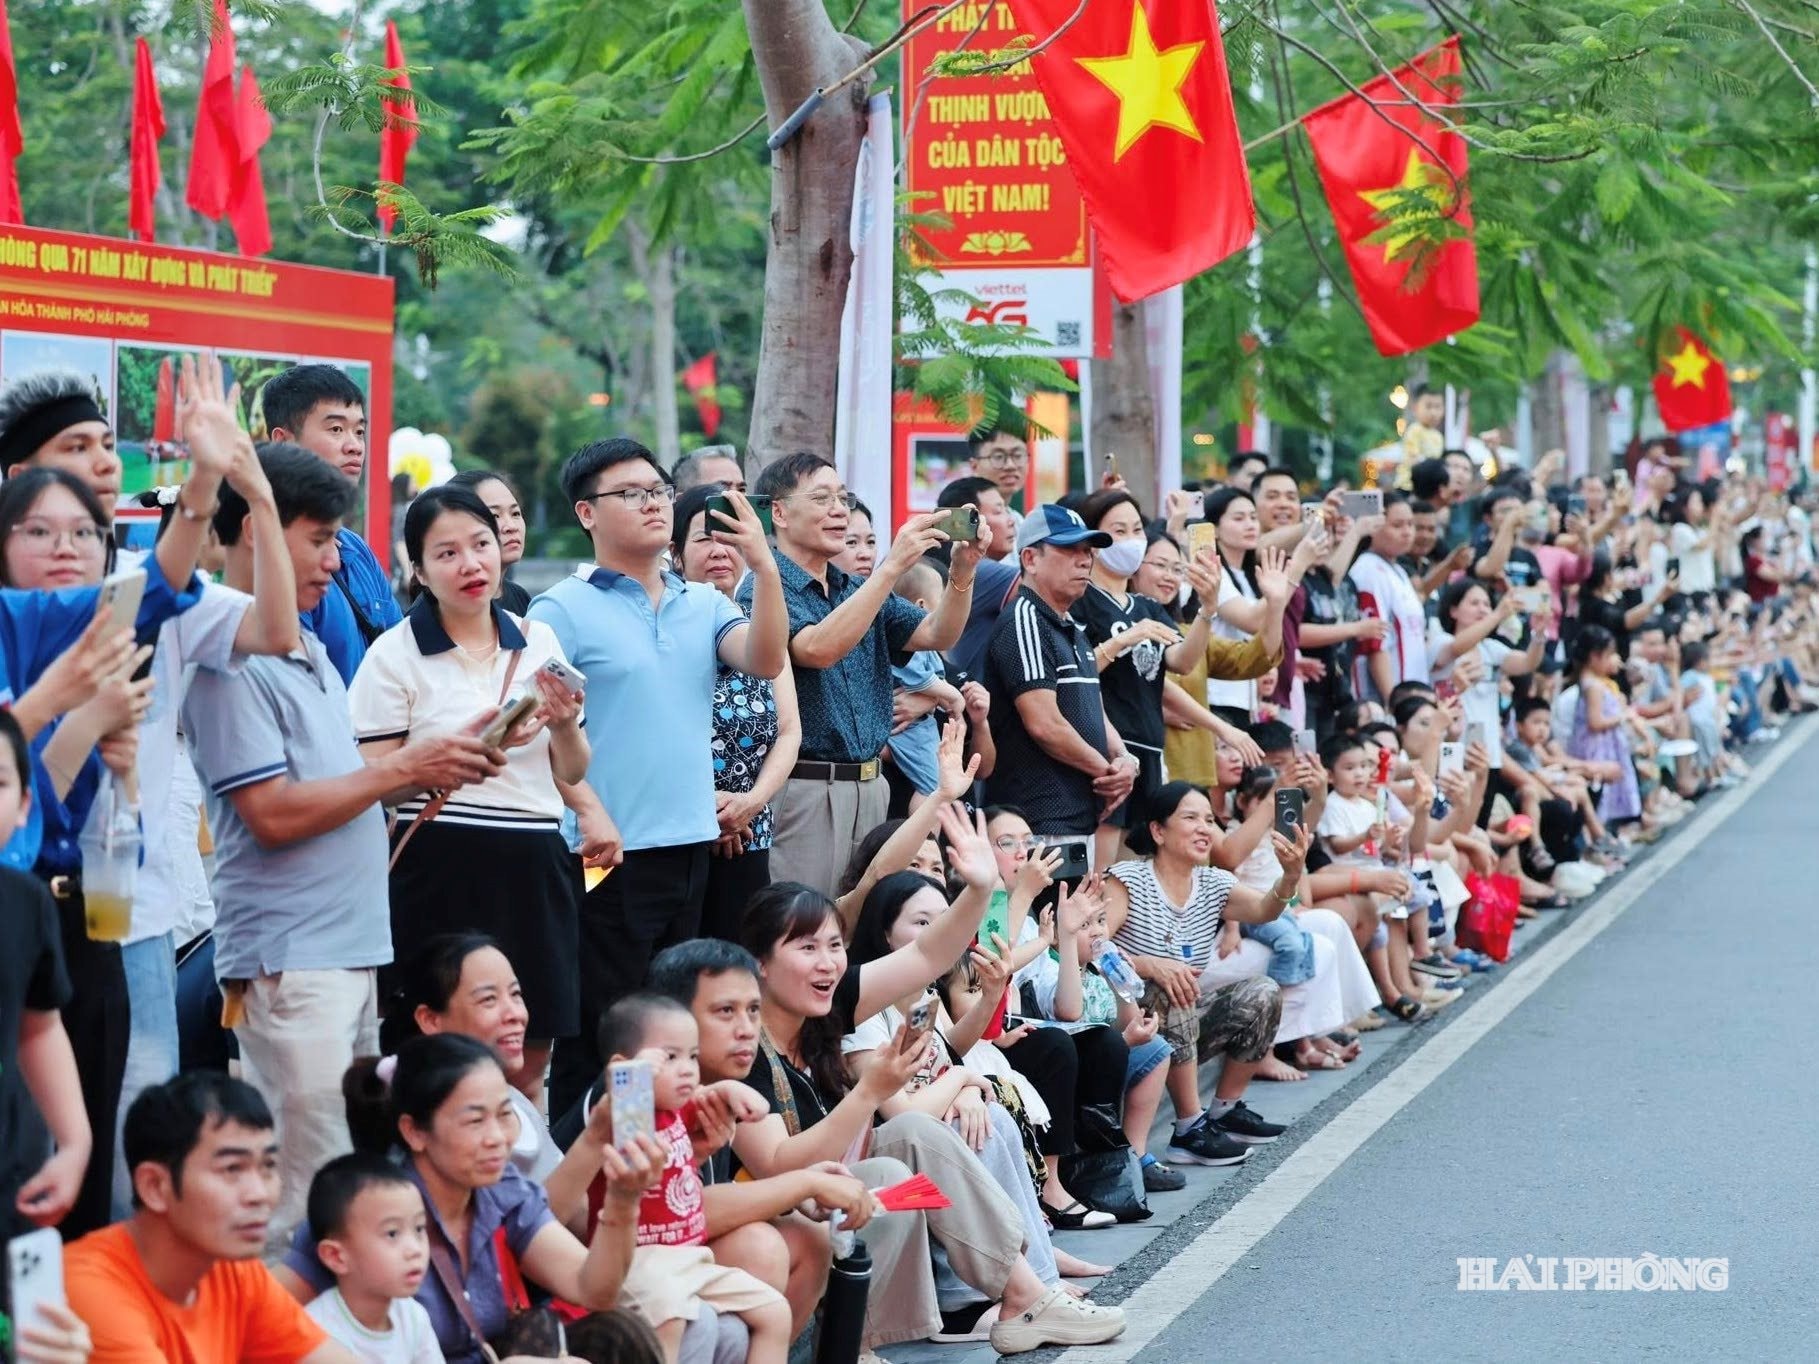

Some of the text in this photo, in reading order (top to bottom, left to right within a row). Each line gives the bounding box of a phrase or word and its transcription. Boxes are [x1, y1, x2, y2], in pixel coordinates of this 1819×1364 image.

[937, 0, 988, 33] PHÁT
[927, 94, 990, 129] THỊNH
[928, 131, 1066, 171] CỦA DÂN TỘC
[942, 179, 1050, 219] VIỆT NAM!
[40, 243, 69, 273] QUA
[71, 247, 87, 274] 71
